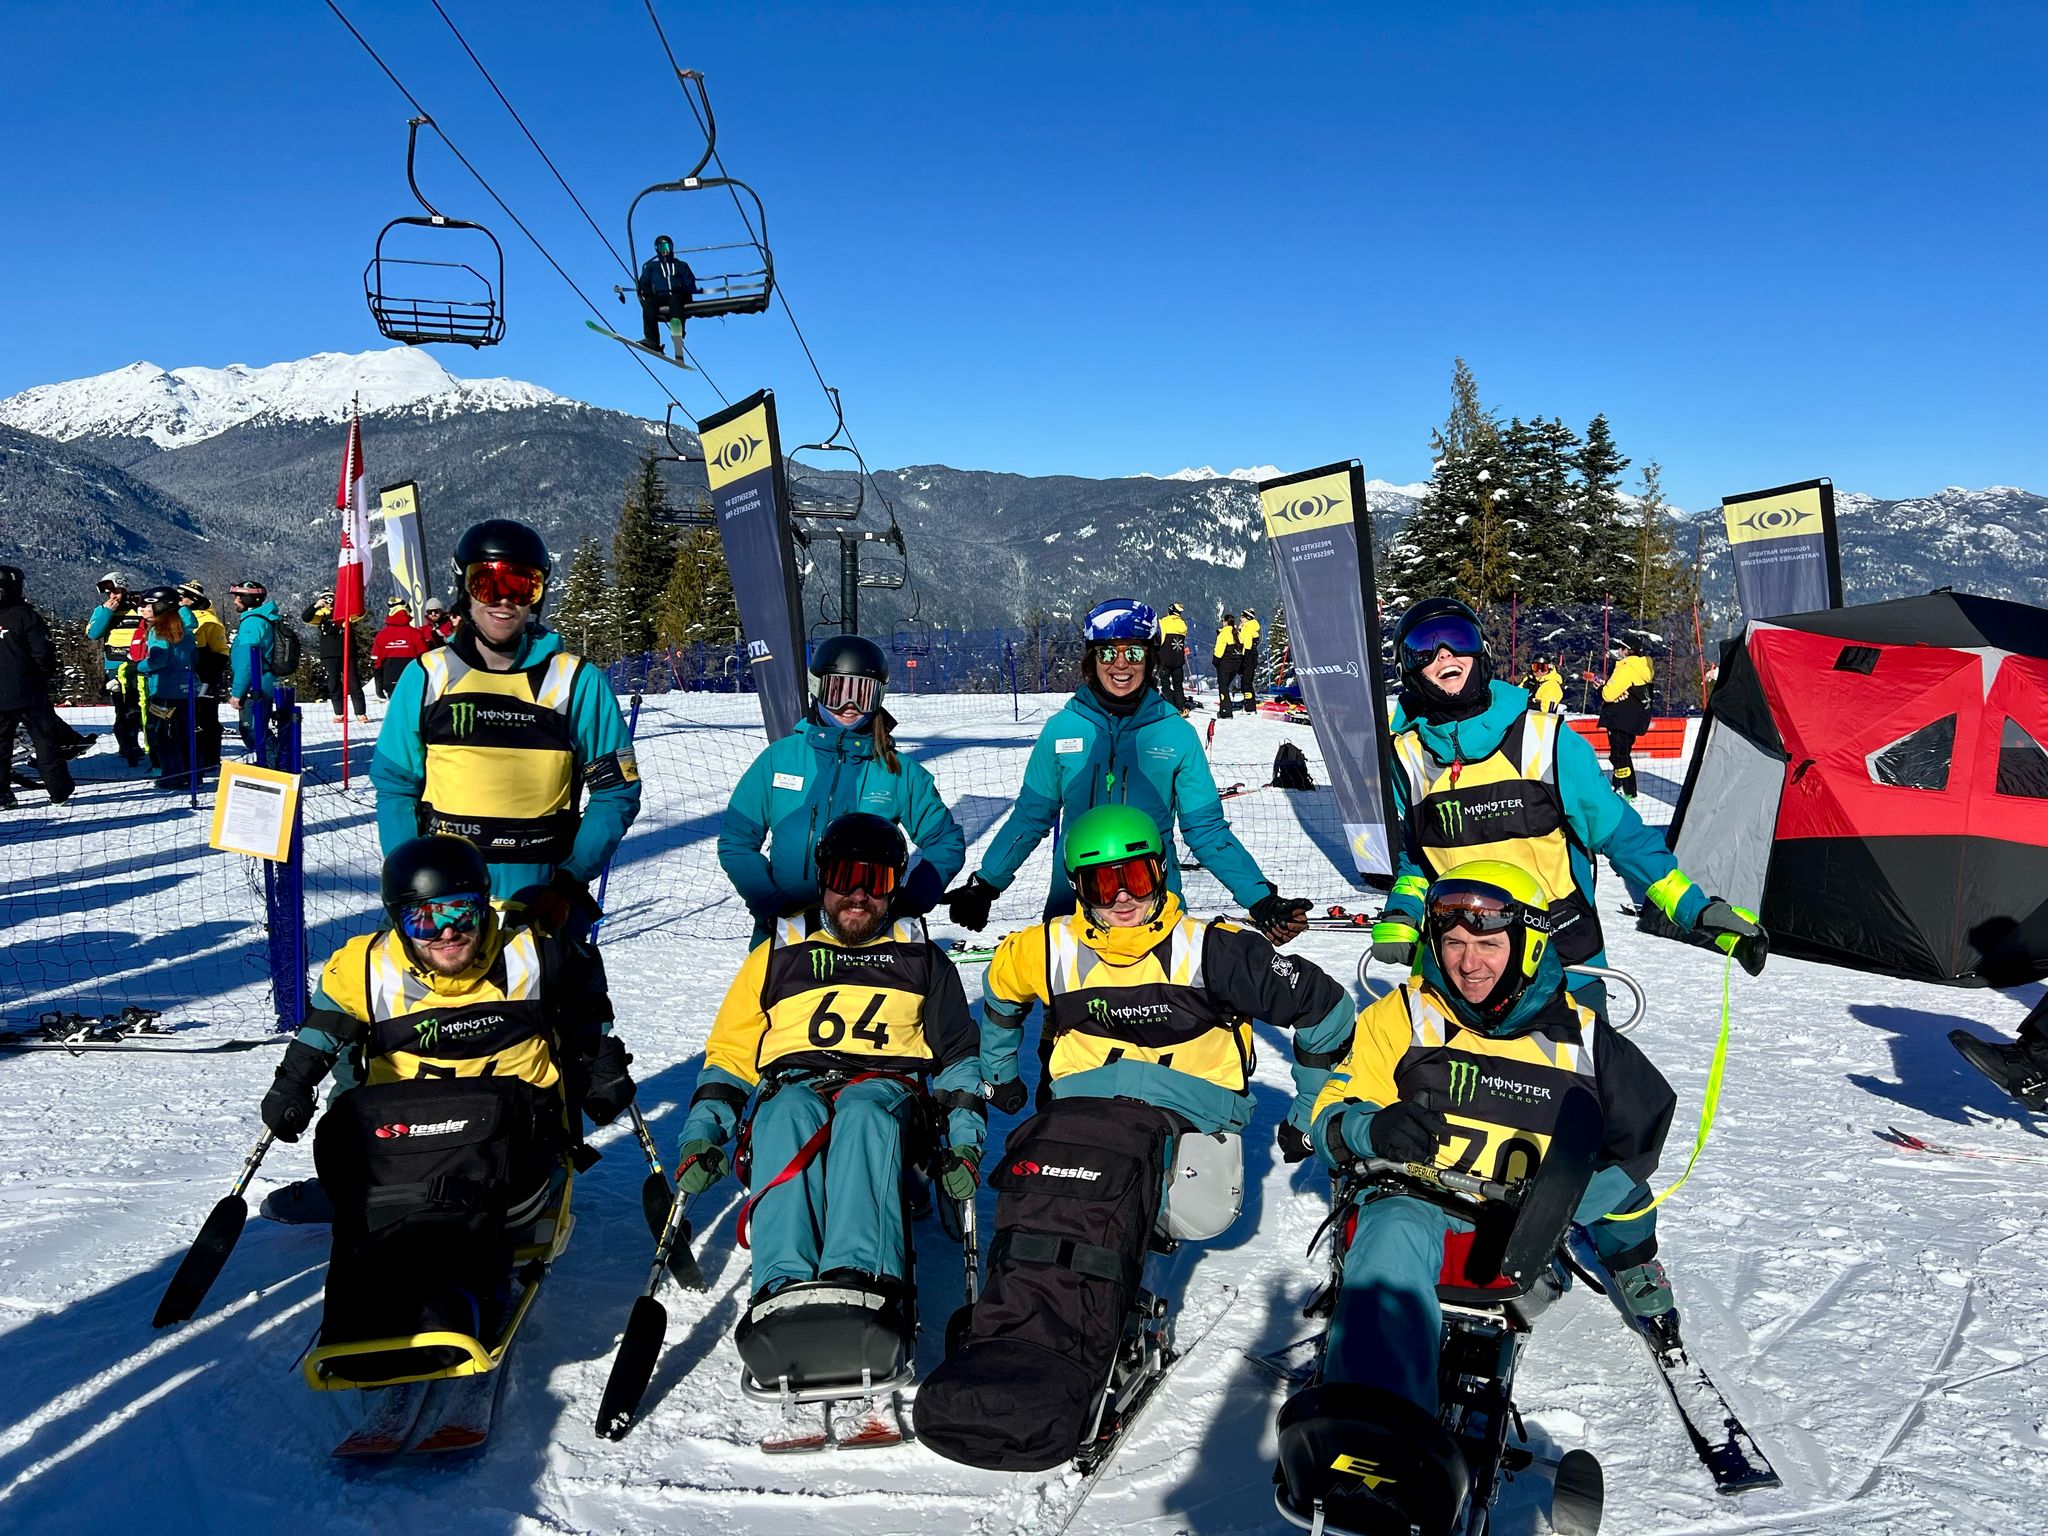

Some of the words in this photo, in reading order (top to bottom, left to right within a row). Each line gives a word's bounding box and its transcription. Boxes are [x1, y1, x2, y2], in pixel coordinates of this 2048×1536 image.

[1474, 810, 1516, 821] ENERGY
[808, 990, 890, 1050] 64
[1490, 1089, 1541, 1105] ENERGY
[408, 1119, 469, 1135] tessier
[1041, 1164, 1102, 1181] tessier
